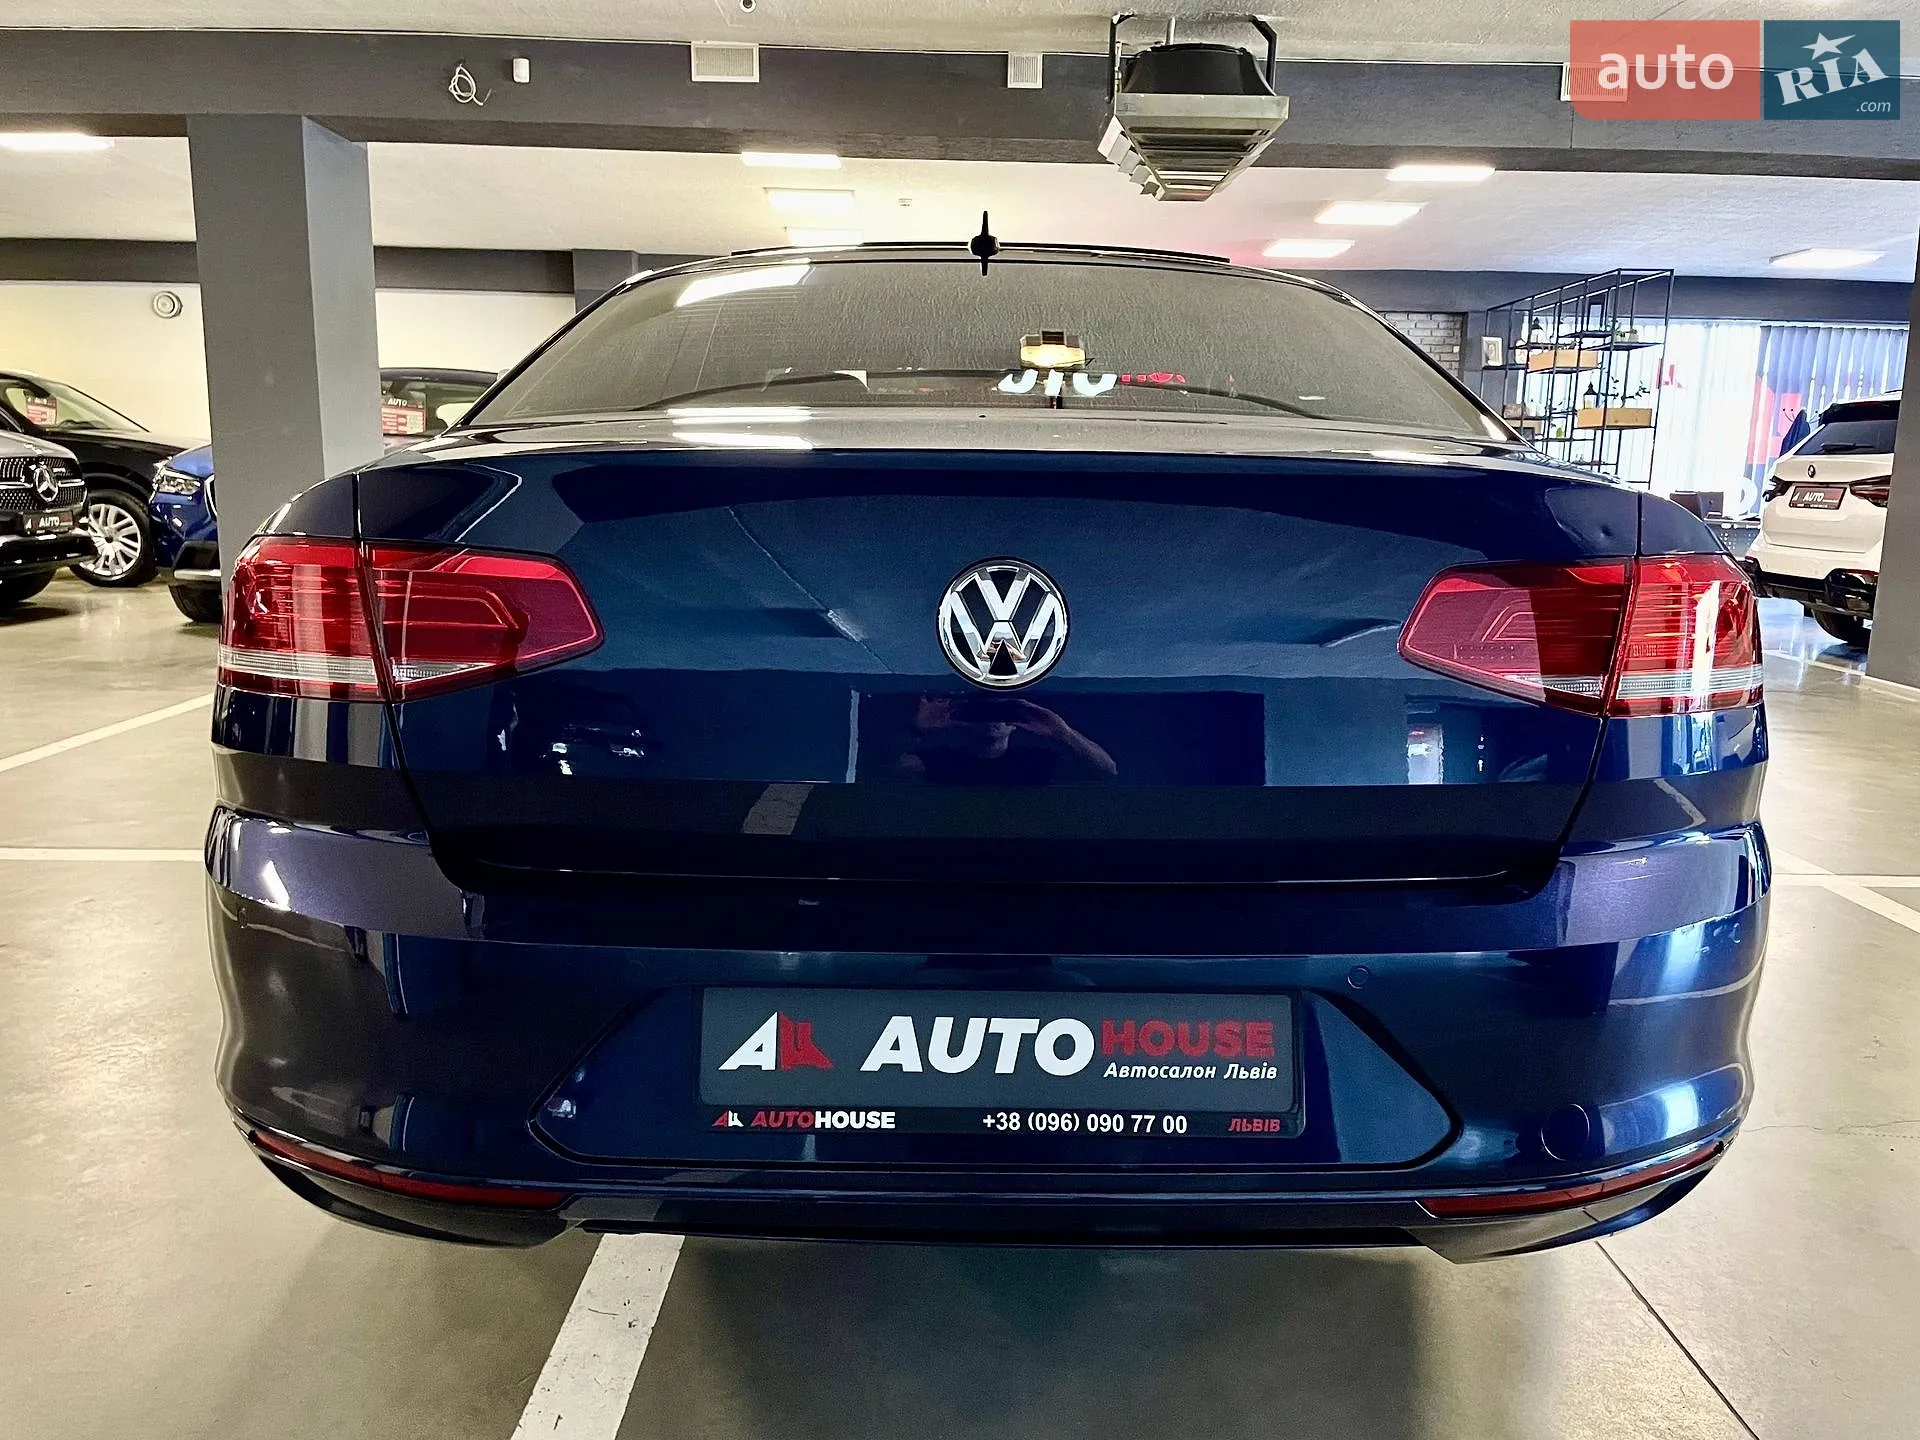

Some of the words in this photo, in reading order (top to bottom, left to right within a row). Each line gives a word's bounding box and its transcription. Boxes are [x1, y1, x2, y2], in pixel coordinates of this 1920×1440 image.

[38, 516, 60, 528] AUTO
[1103, 1061, 1217, 1080] Автосалон
[1223, 1062, 1278, 1081] Львів
[982, 1111, 1021, 1132] +38
[1027, 1112, 1081, 1133] (096)
[1086, 1113, 1125, 1134] 090
[1131, 1113, 1156, 1134] 77
[1162, 1114, 1188, 1135] 00
